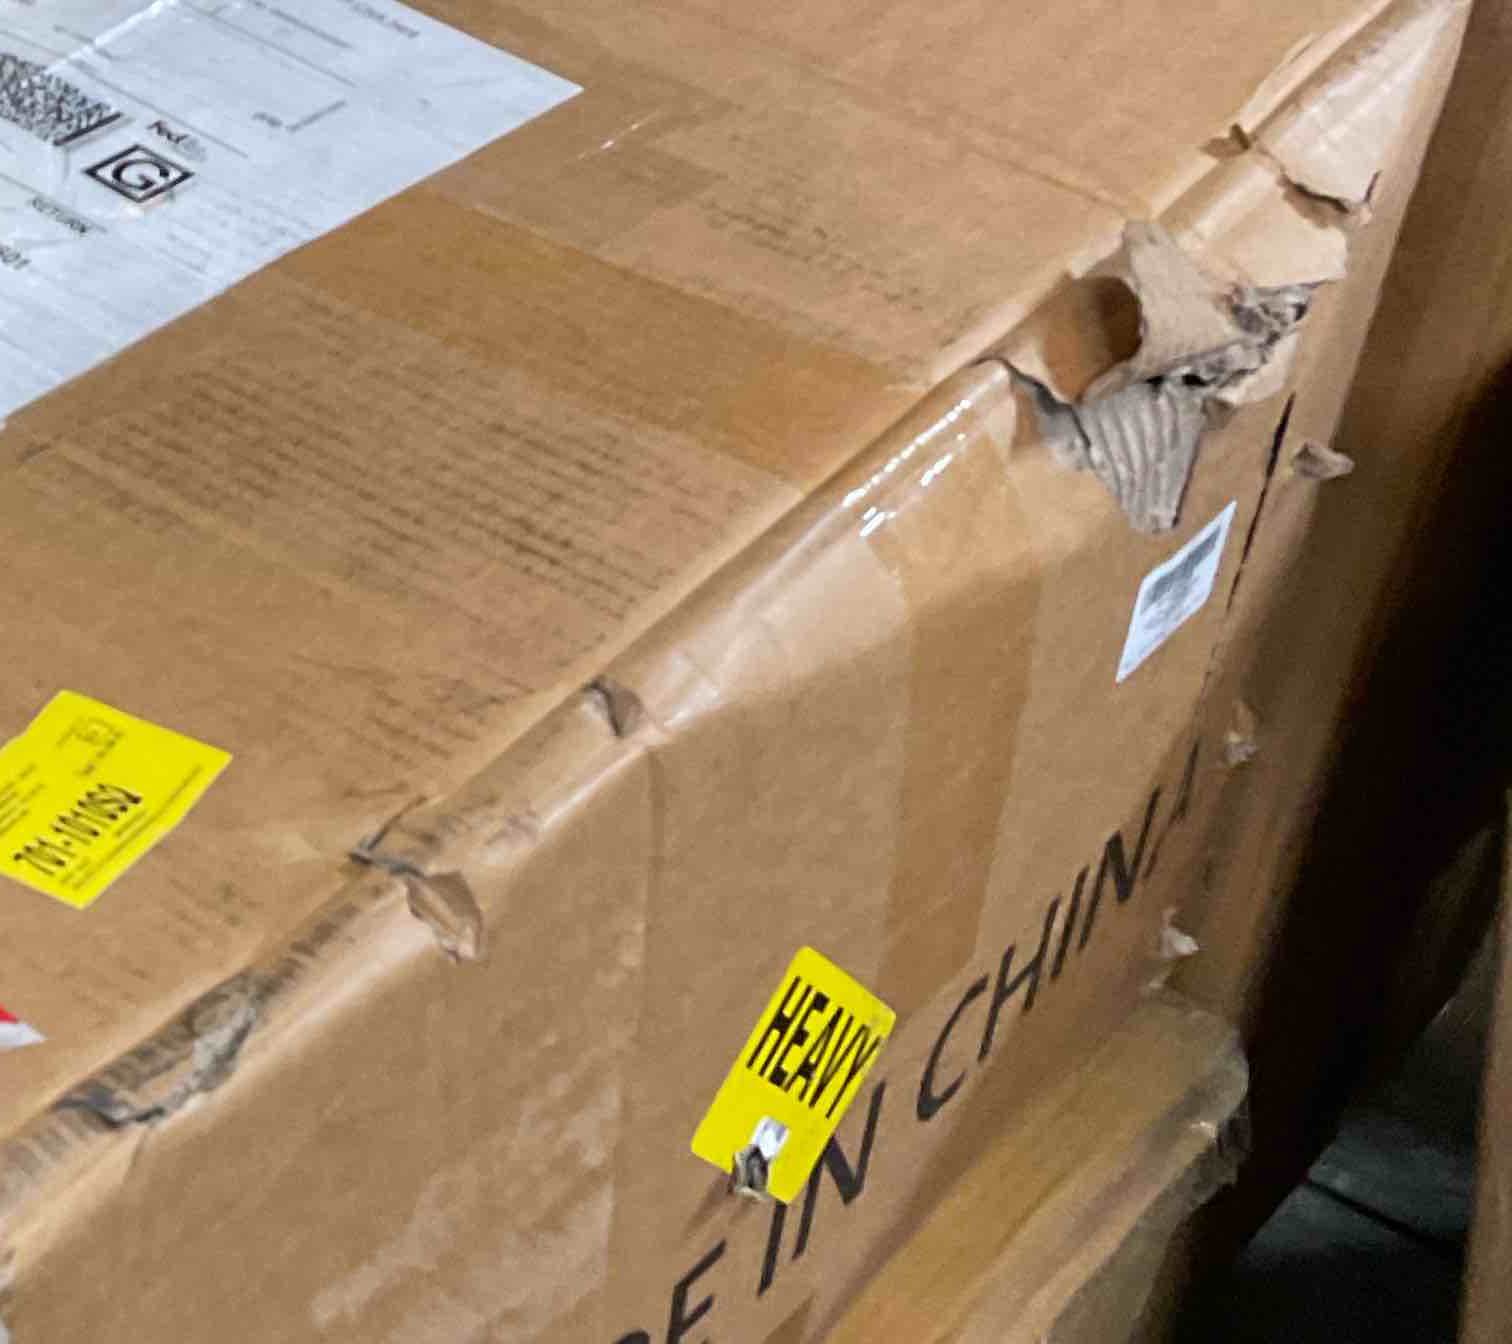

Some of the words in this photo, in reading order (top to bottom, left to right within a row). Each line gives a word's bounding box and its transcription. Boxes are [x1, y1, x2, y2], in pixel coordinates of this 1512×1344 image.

[110, 156, 171, 192] G
[746, 974, 882, 1119] HEAVY
[759, 1079, 886, 1296] IN
